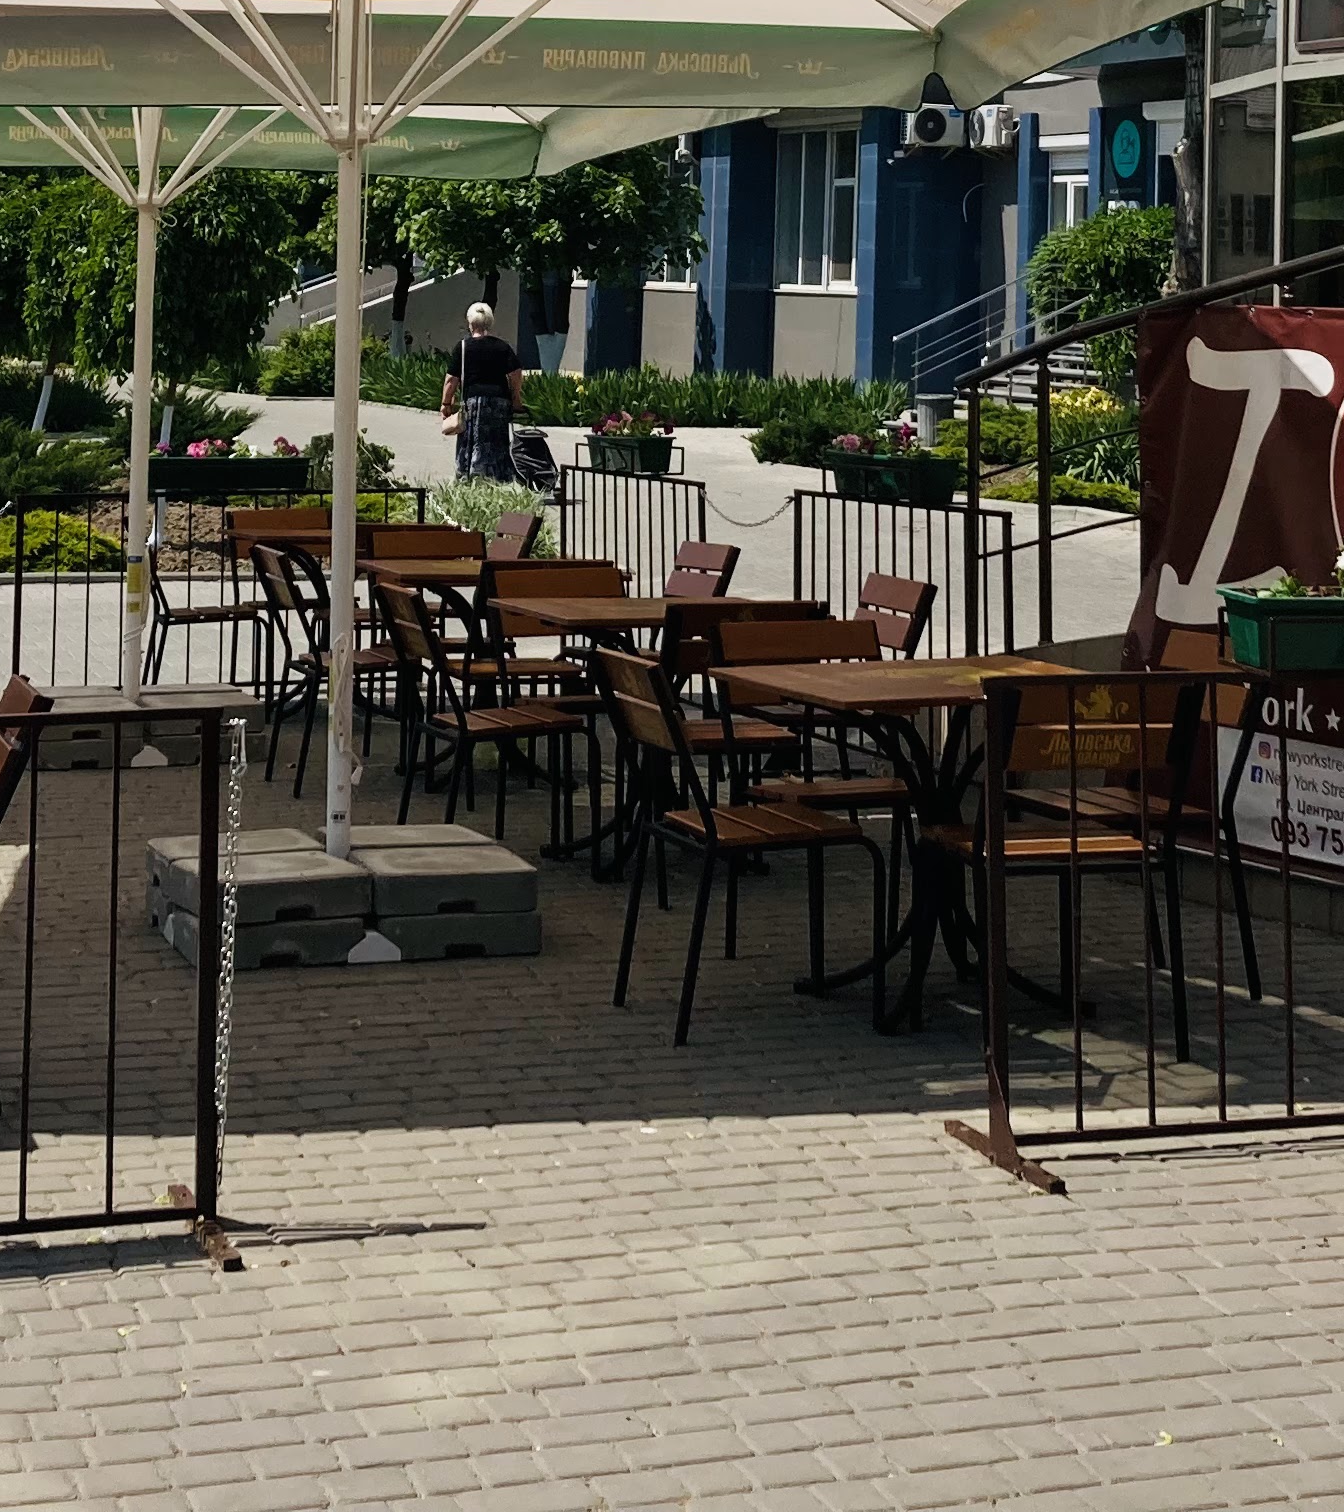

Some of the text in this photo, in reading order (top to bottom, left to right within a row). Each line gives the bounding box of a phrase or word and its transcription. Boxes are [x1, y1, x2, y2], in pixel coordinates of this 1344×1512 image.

[1156, 336, 1334, 625] I
[1242, 682, 1315, 735] ork
[1294, 775, 1318, 792] York
